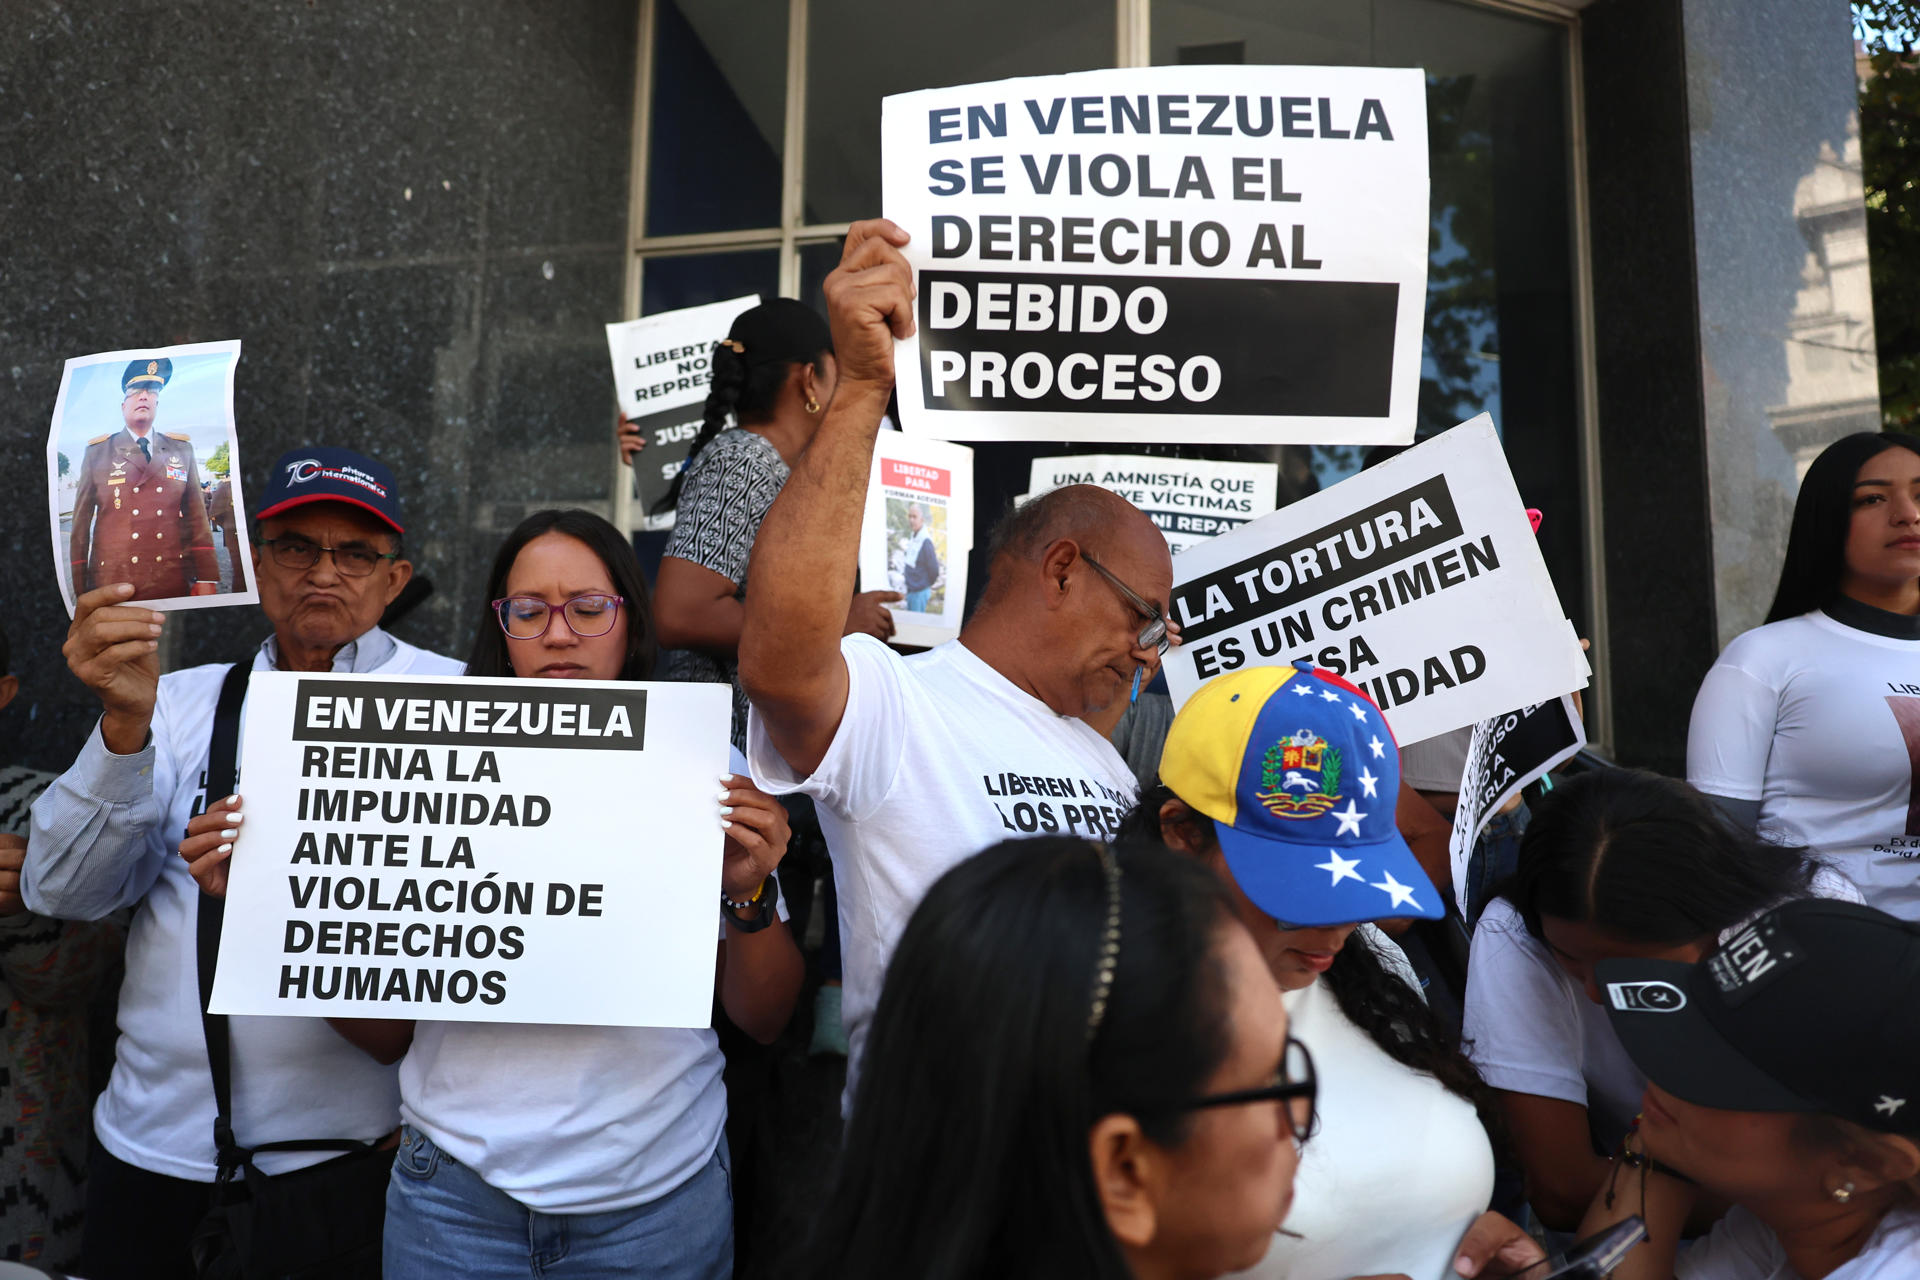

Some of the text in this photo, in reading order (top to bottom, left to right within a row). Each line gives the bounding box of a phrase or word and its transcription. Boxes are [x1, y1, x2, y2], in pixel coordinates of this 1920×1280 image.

[929, 95, 1394, 144] EN VENEZUELA
[928, 154, 1302, 202] SE VIOLA EL
[931, 215, 1322, 270] DERECHO AL
[929, 281, 1168, 335] DEBIDO
[677, 358, 708, 375] NO
[931, 350, 1222, 402] PROCESO
[893, 463, 939, 480] LIBERTAD
[905, 476, 931, 489] PARA
[1053, 471, 1254, 493] UNA AMNISTÍA QUE
[1152, 489, 1251, 512] VÍCTIMAS
[1150, 514, 1172, 528] NI
[1176, 498, 1443, 628] LA TORTURA
[1192, 534, 1501, 681] ES UN CRIMEN
[306, 696, 633, 737] EN VENEZUELA
[301, 746, 501, 783] REINA LA
[983, 773, 1077, 798] LIBEREN
[1080, 779, 1095, 798] A
[297, 789, 551, 827] IMPUNIDAD
[993, 802, 1060, 833] LOS
[290, 832, 475, 869] ANTE LA
[1873, 844, 1913, 859] David
[1891, 838, 1906, 847] Ex
[288, 872, 603, 917] VIOLACIÓN DE
[283, 920, 524, 960] DERECHOS
[1728, 926, 1777, 982] VEN
[278, 965, 506, 1005] HUMANOS
